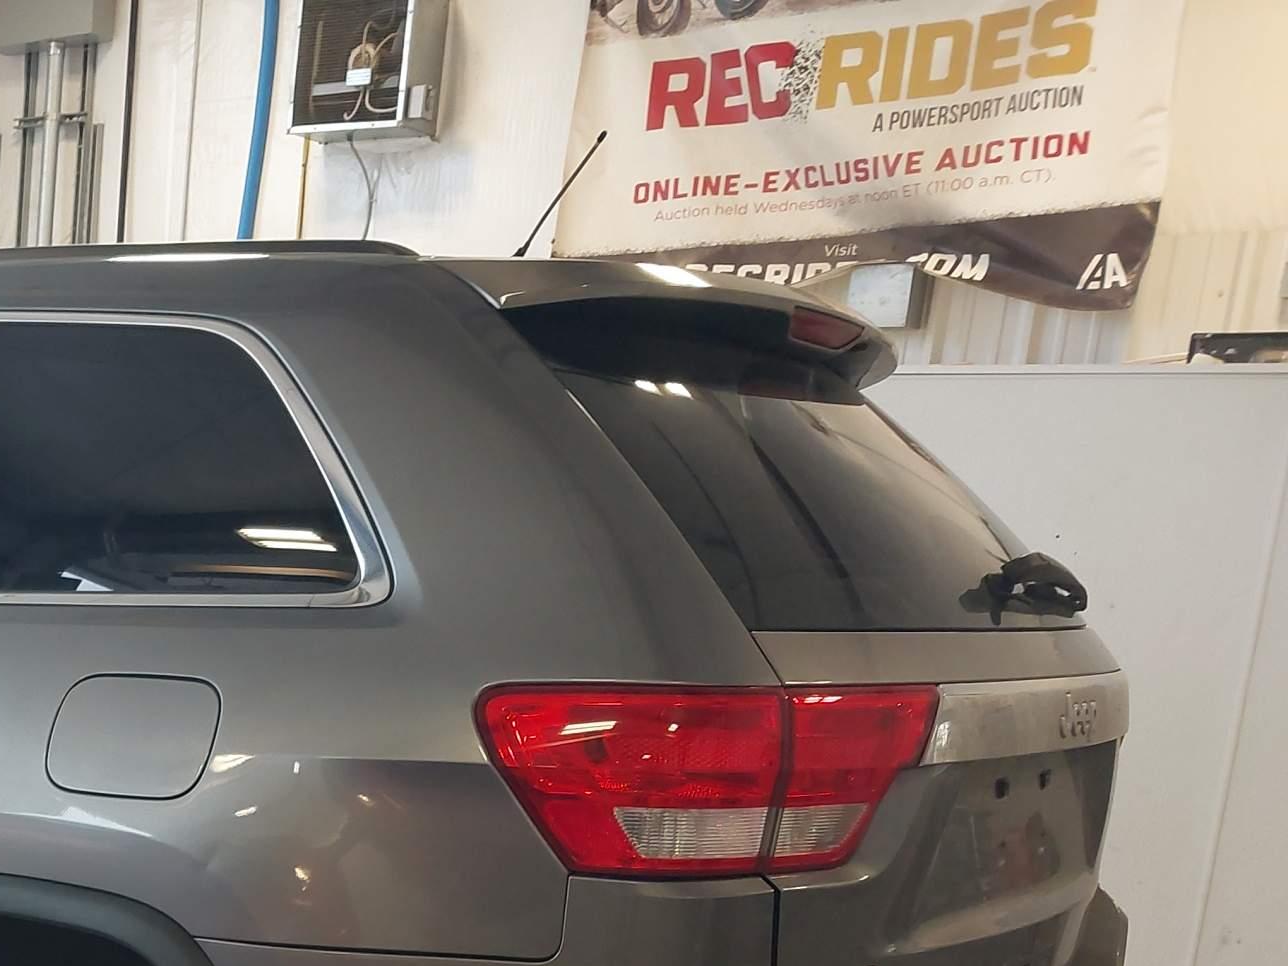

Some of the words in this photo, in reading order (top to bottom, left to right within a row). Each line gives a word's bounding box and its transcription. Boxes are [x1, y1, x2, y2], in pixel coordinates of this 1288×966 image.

[646, 41, 797, 131] REC
[815, 0, 1098, 110] RIDES
[872, 113, 884, 132] A
[888, 96, 1005, 131] POWERSPORT
[1006, 85, 1084, 115] AUCTION
[633, 151, 924, 204] ONLINE-EXCLUSIVE
[934, 130, 1091, 172] AUCTION
[654, 203, 710, 222] Auction
[715, 202, 748, 216] held
[754, 192, 845, 214] Wednesdays
[864, 189, 899, 203] noon
[903, 182, 921, 198] ET
[926, 175, 974, 195] (11:00
[825, 244, 859, 257] Visit
